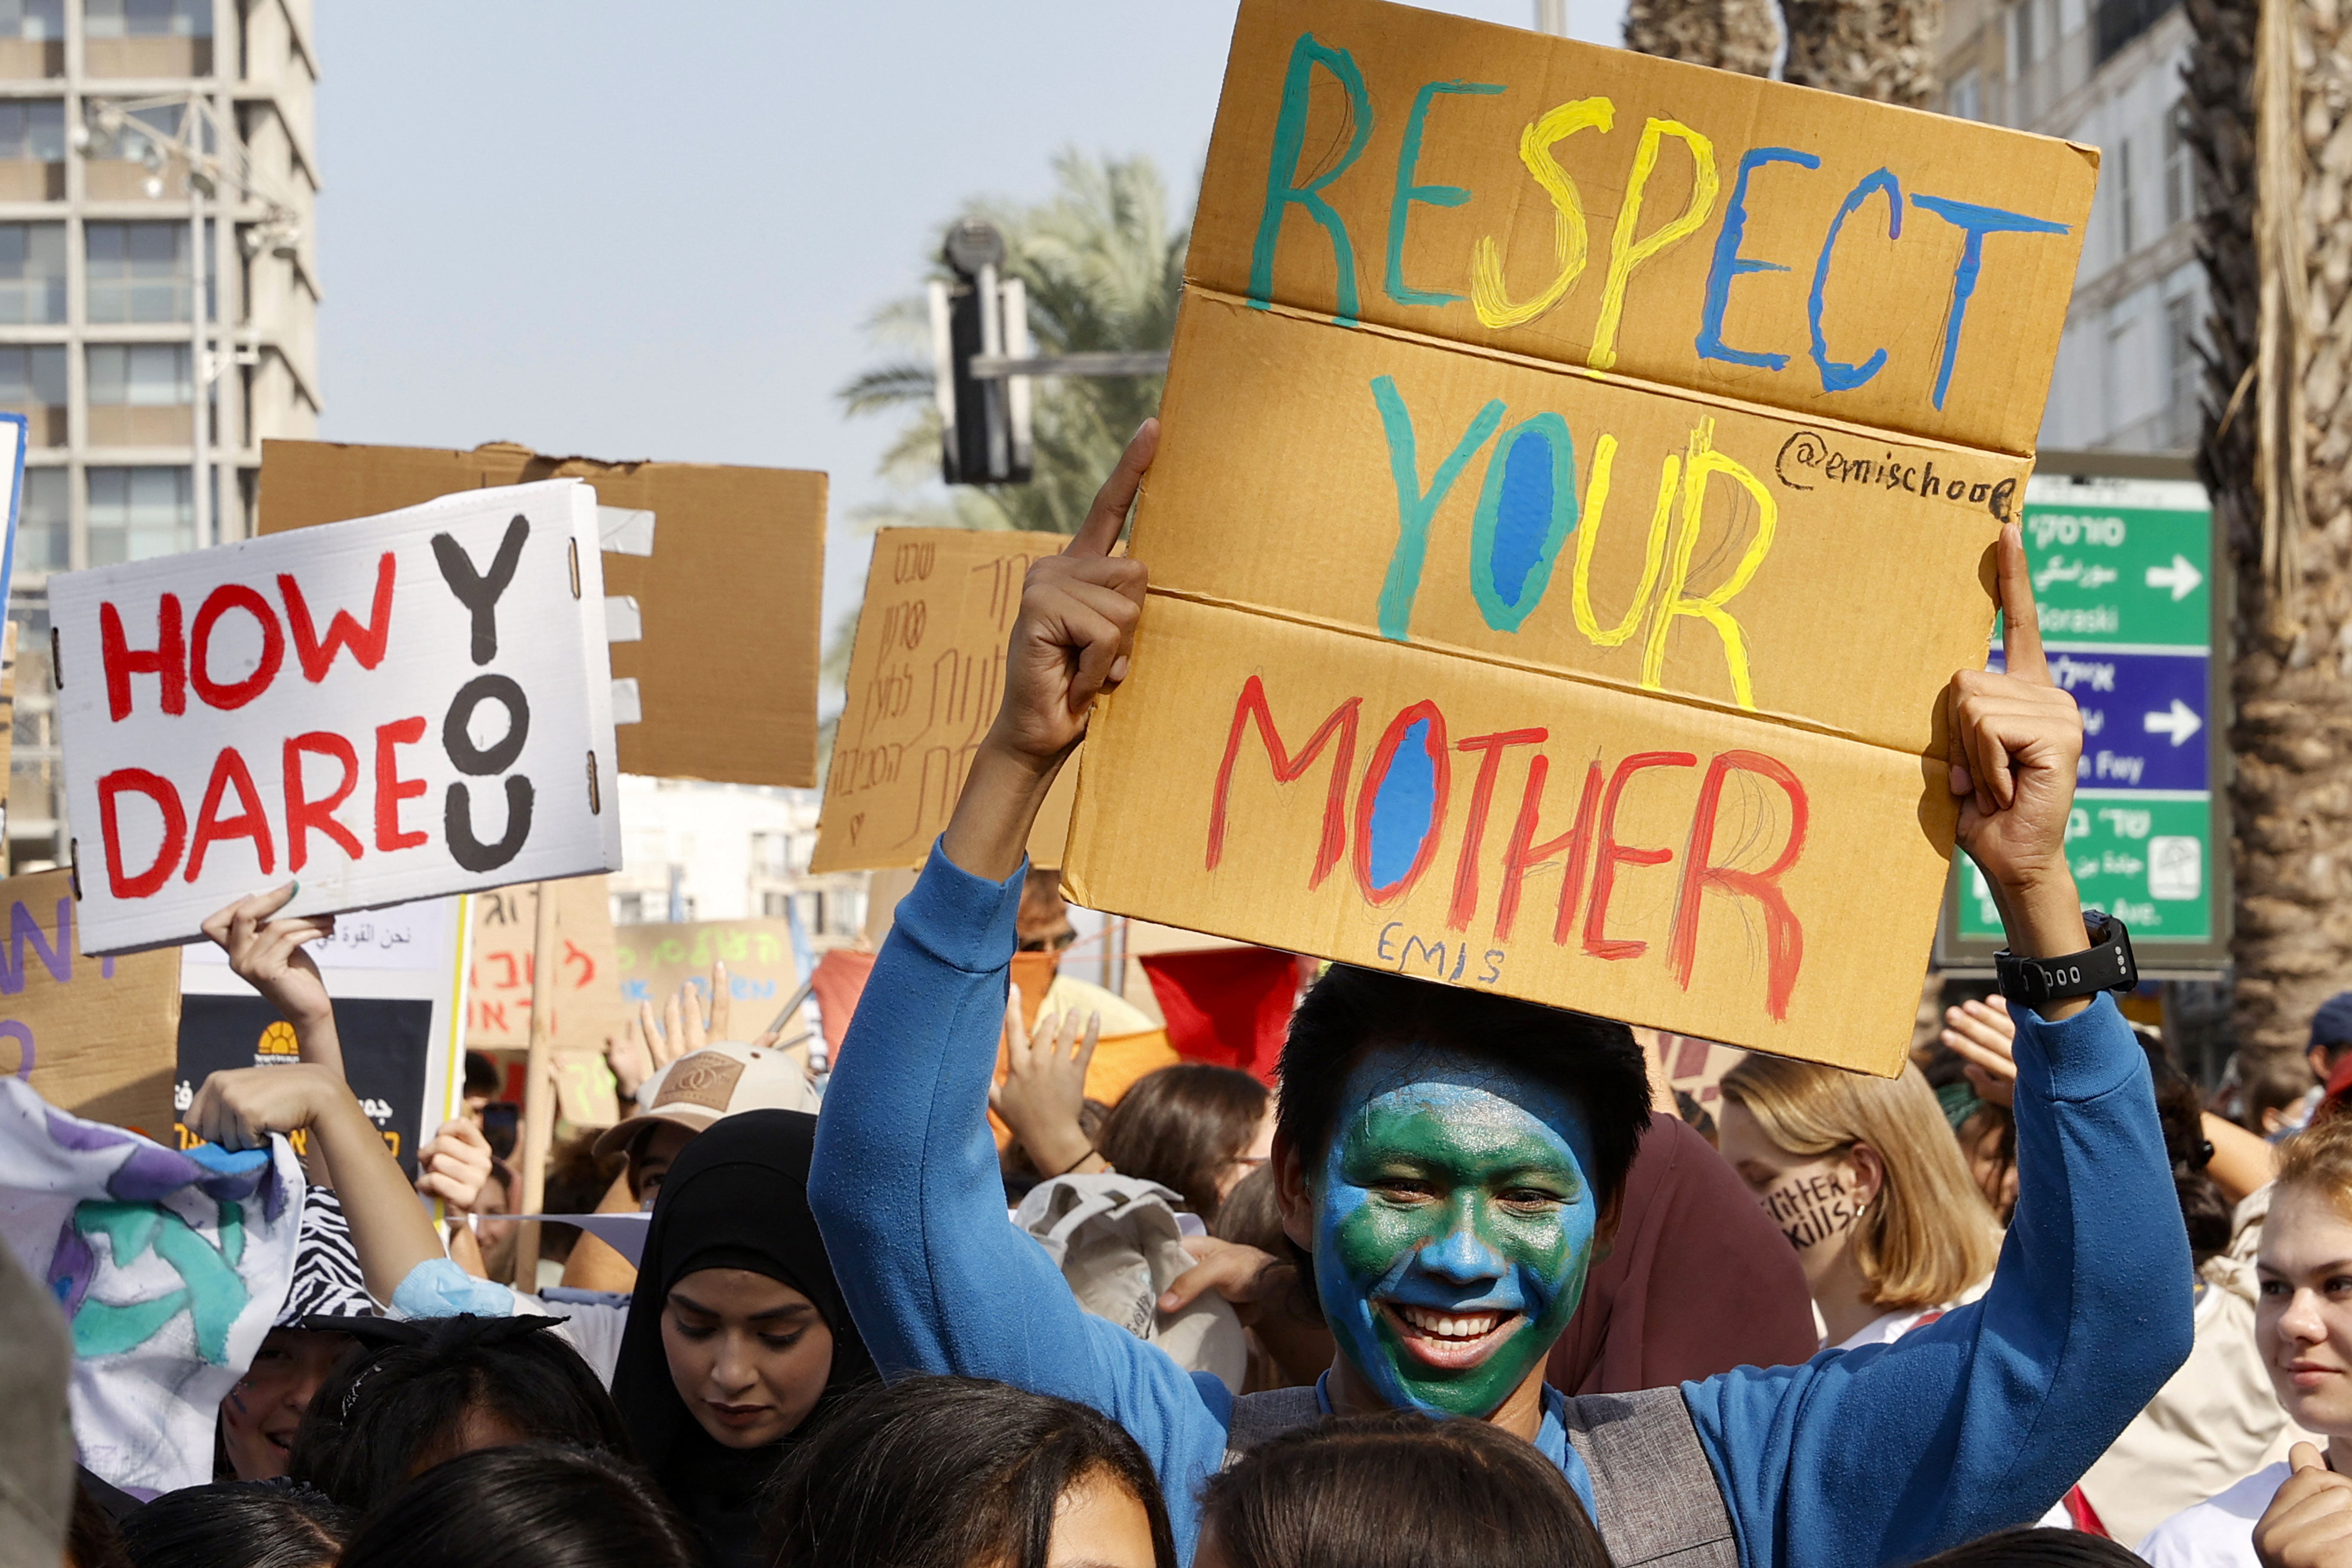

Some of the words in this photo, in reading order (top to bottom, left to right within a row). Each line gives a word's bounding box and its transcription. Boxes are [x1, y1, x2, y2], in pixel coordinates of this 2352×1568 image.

[1246, 32, 2071, 410] RESPECT
[100, 552, 395, 722] HOW
[432, 514, 534, 873] YOU
[1370, 375, 1777, 712] YOUR
[97, 716, 428, 898] DARE
[1206, 675, 1810, 1022] MOTHER
[1378, 922, 1504, 983] EMIS
